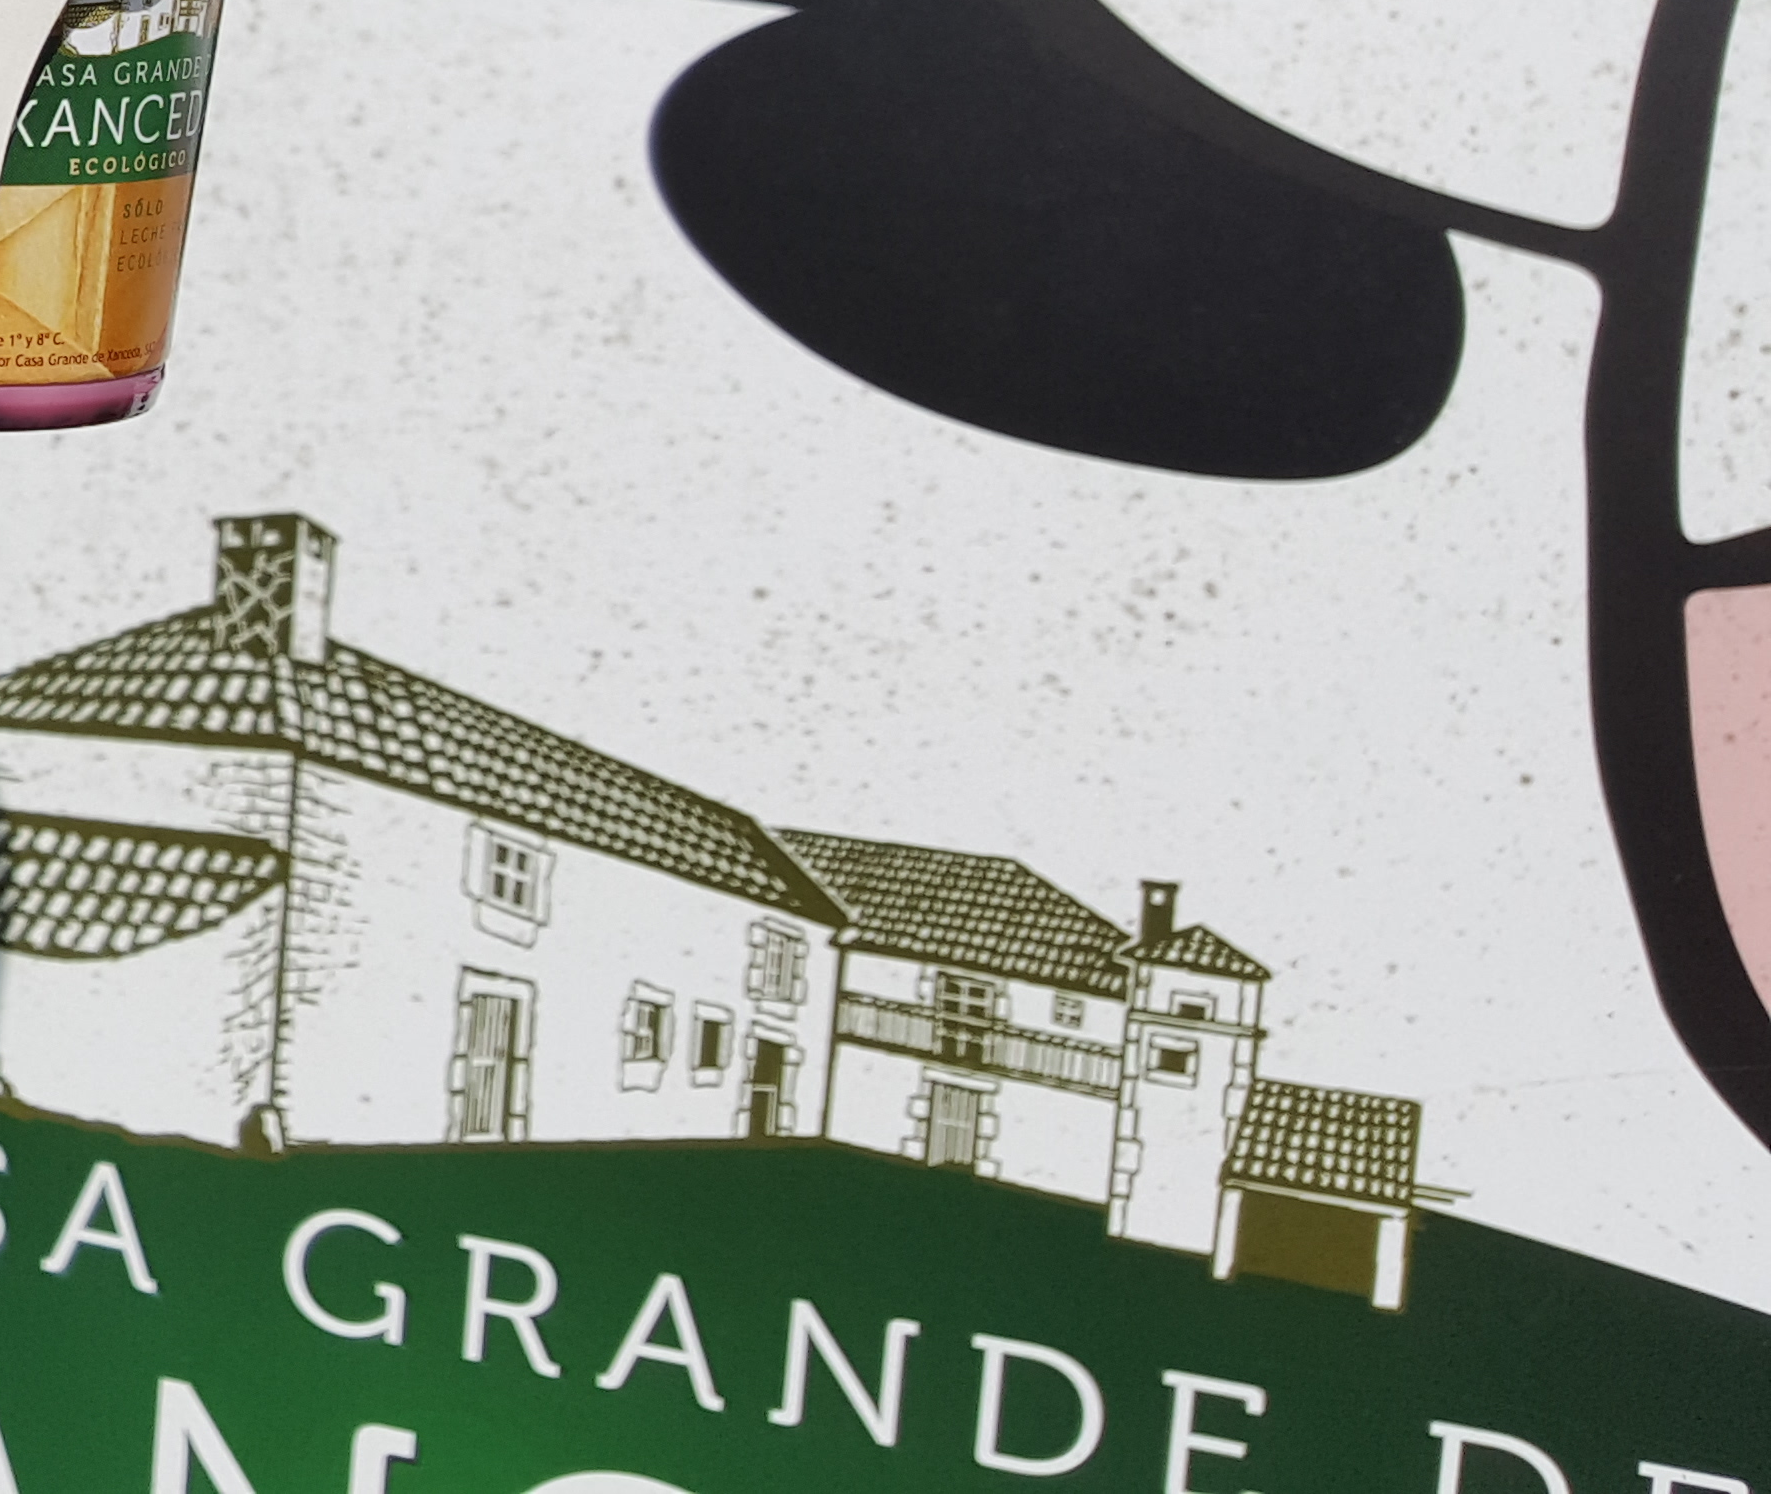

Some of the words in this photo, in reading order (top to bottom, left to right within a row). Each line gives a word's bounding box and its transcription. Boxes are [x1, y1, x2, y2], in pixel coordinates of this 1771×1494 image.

[114, 56, 202, 85] GRANDE
[69, 149, 187, 176] ECOLÓGICO
[123, 198, 163, 218] SÓLO
[119, 224, 165, 245] LECHE
[25, 336, 33, 349] y
[15, 353, 44, 367] Casa
[48, 352, 88, 366] Grande
[92, 350, 105, 363] de
[283, 1207, 1267, 1494] GRANDE
[1429, 1419, 1750, 1494] D
